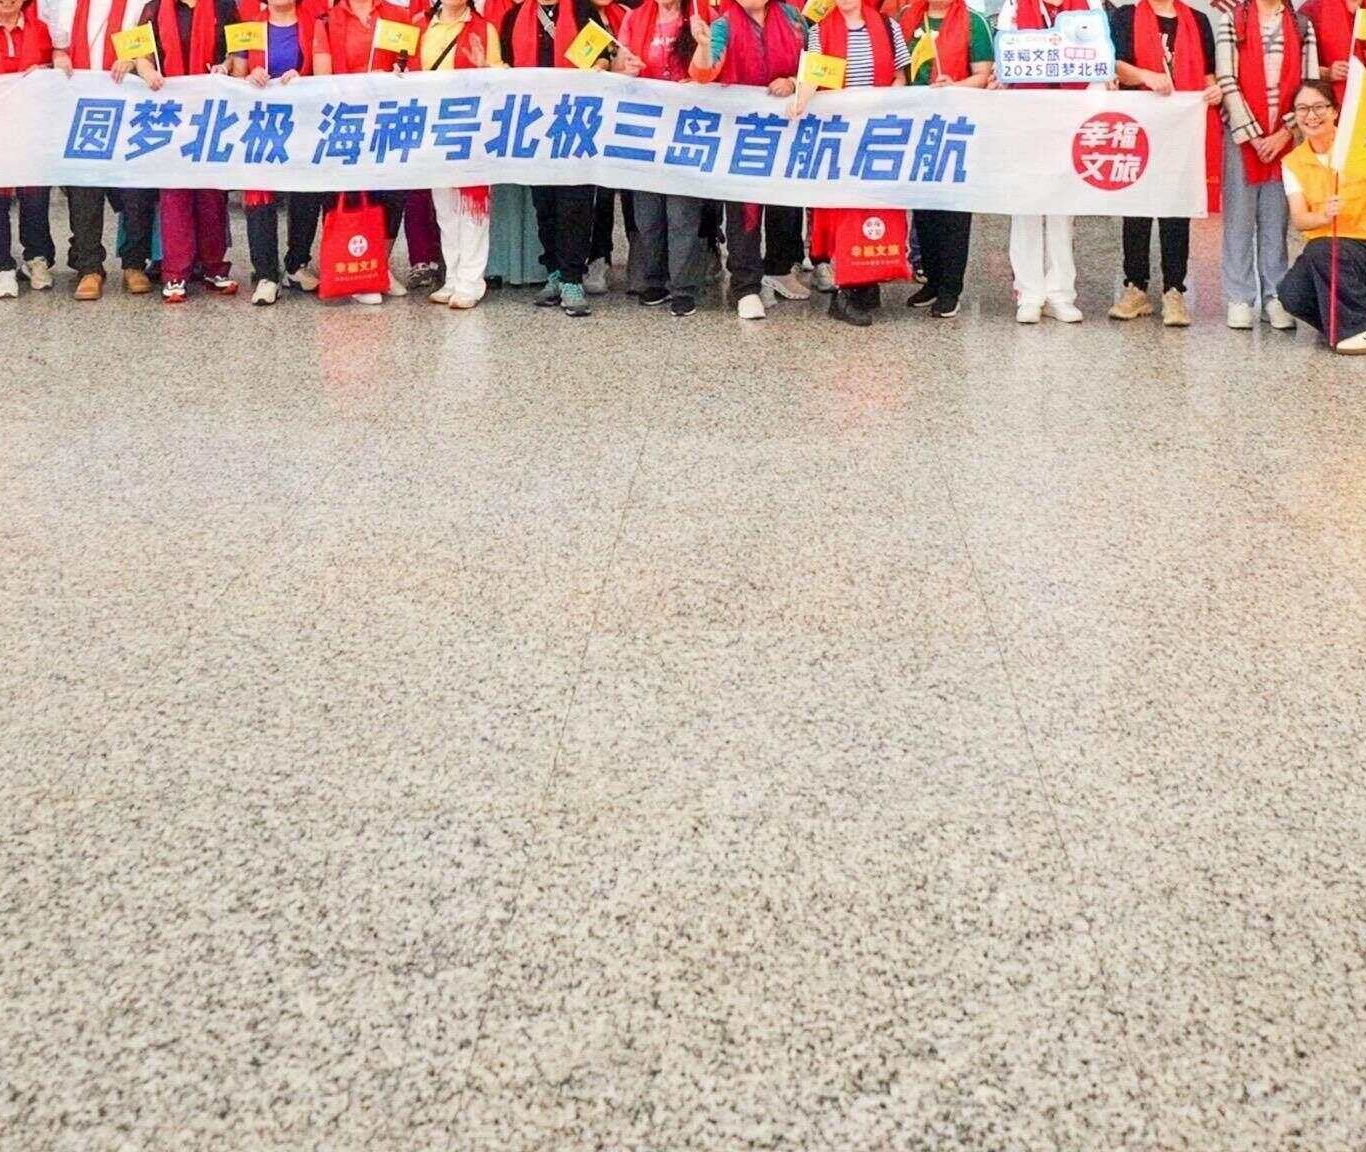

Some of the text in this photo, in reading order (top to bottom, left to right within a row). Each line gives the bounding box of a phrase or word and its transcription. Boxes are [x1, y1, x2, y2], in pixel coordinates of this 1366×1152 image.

[1003, 49, 1060, 62] 幸福文旅
[1004, 62, 1108, 77] 2025圆梦北极
[63, 93, 976, 183] 圆梦北极 海神号北极三岛首航启航
[1075, 121, 1139, 148] 幸福
[1077, 152, 1142, 182] 文旅
